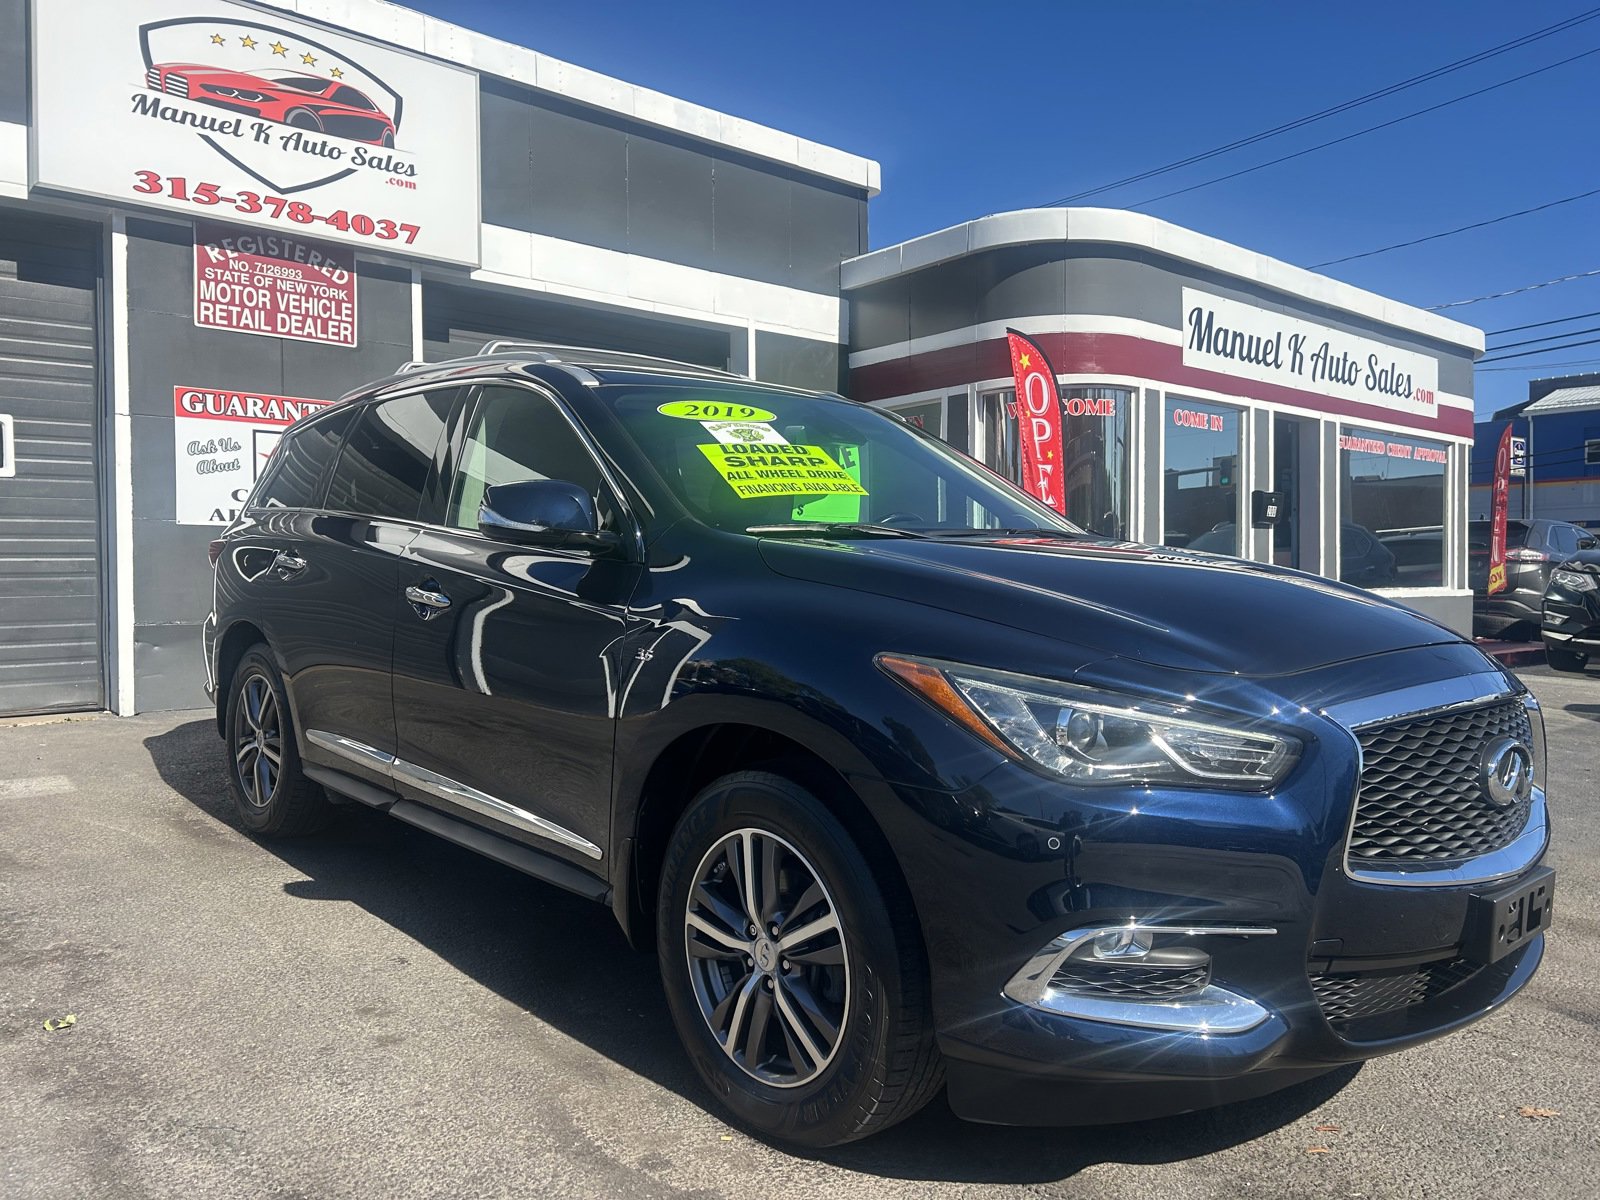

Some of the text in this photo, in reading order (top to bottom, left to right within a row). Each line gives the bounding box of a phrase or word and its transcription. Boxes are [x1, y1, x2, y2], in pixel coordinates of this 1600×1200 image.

[131, 93, 418, 177] Manuel K Auto Sales
[385, 177, 417, 190] .com
[132, 170, 421, 245] 315-378-4037
[201, 235, 349, 285] REGISTERED
[229, 258, 303, 280] NO. 7126993
[204, 267, 348, 301] STATE OF NEW YORK
[199, 279, 353, 322] MOTOR VEHICLE
[199, 301, 353, 343] RETAIL DEALER
[1188, 306, 1283, 370] Manuel
[1287, 333, 1307, 376] K
[1310, 341, 1362, 386] Auto
[1365, 353, 1413, 399] Sales
[180, 390, 331, 421] GUARANT
[684, 404, 756, 419] 2019
[1173, 408, 1224, 432] COME IN
[187, 437, 242, 456] Ask Us
[720, 444, 809, 455] LOADED
[1024, 371, 1057, 508] OPE
[196, 458, 241, 475] About
[723, 456, 826, 467] SHARP
[727, 470, 849, 481] ALL WHEEL DRIVE
[737, 483, 864, 495] FINANCING AVAILABLE
